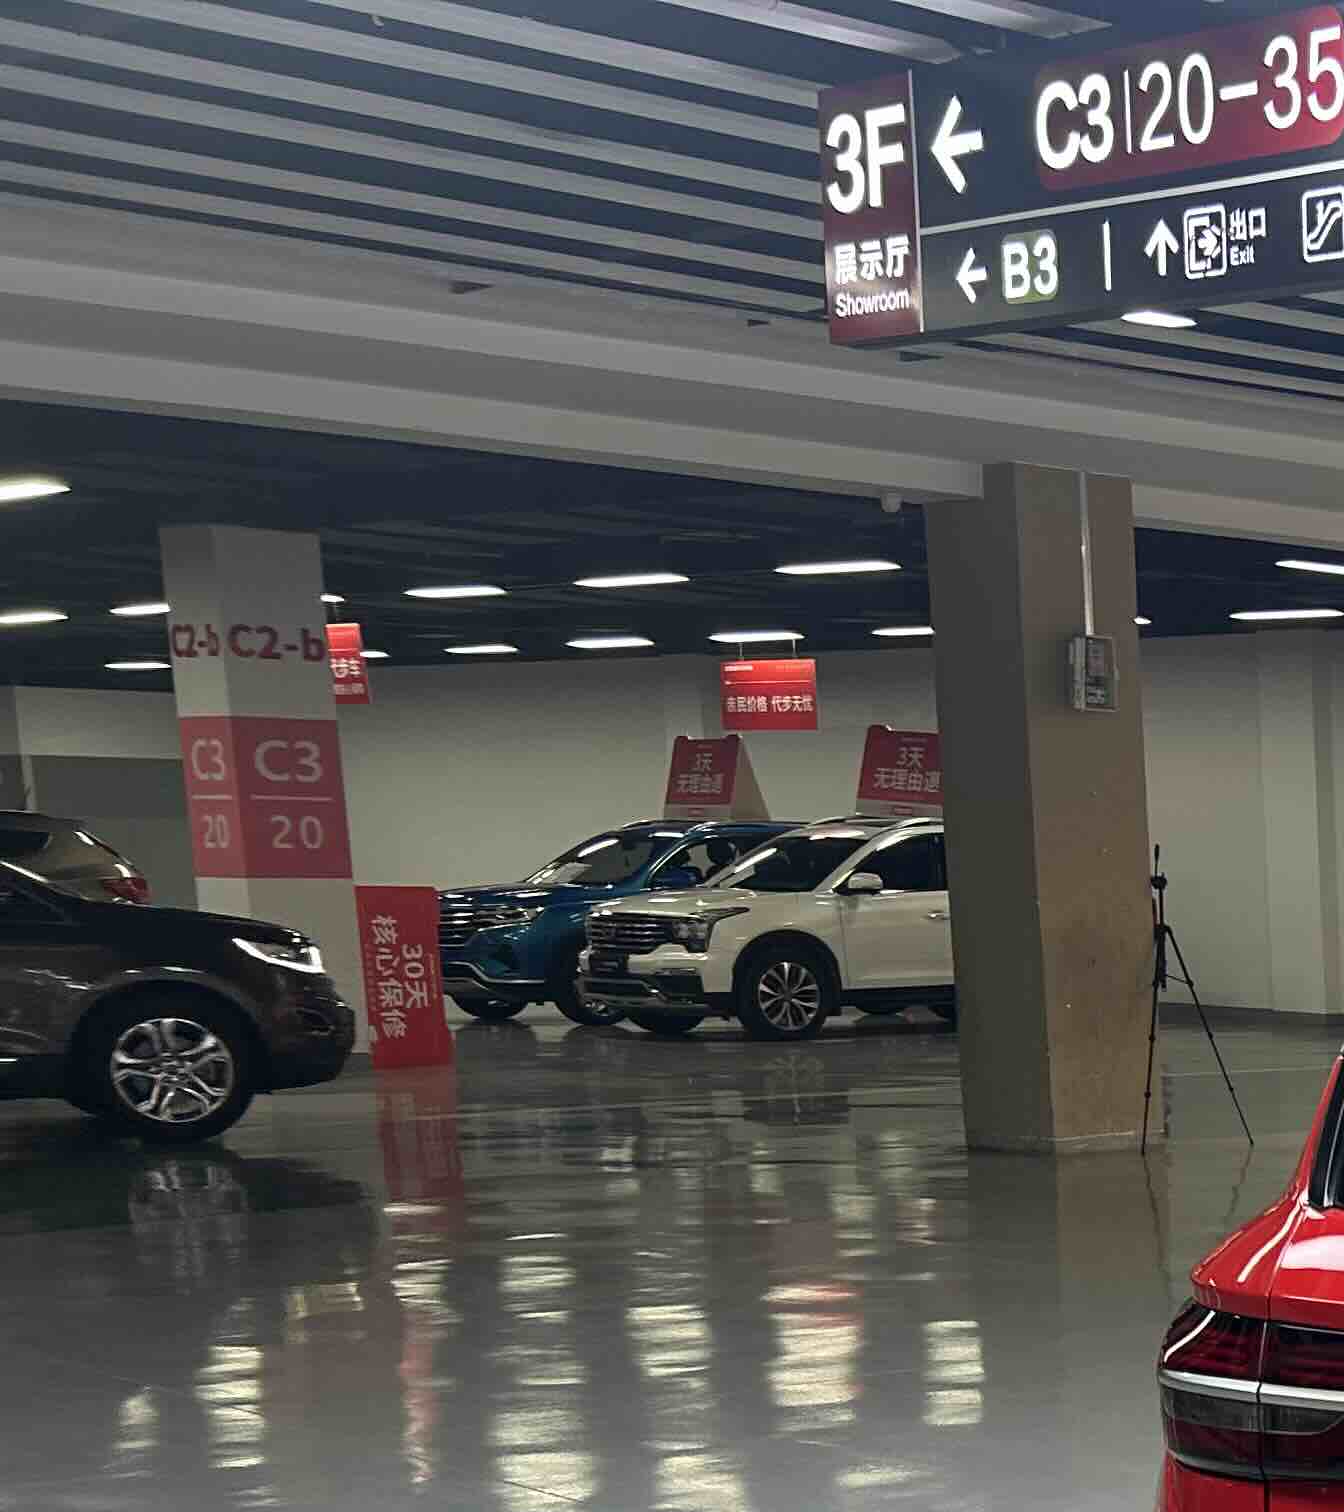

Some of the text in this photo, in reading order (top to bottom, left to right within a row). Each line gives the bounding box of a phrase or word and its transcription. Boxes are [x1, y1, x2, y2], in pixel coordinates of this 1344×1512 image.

[1036, 72, 1114, 170] C3
[826, 103, 905, 214] 3F
[1229, 207, 1267, 241] 出口
[833, 234, 910, 285] 展示厅
[1002, 234, 1059, 300] B3
[1230, 243, 1256, 266] Exit
[834, 288, 911, 319] Showroom
[228, 624, 326, 662] C2-b
[192, 738, 225, 782] C3
[254, 739, 323, 783] C3
[203, 814, 231, 849] 20
[272, 815, 323, 849] 20
